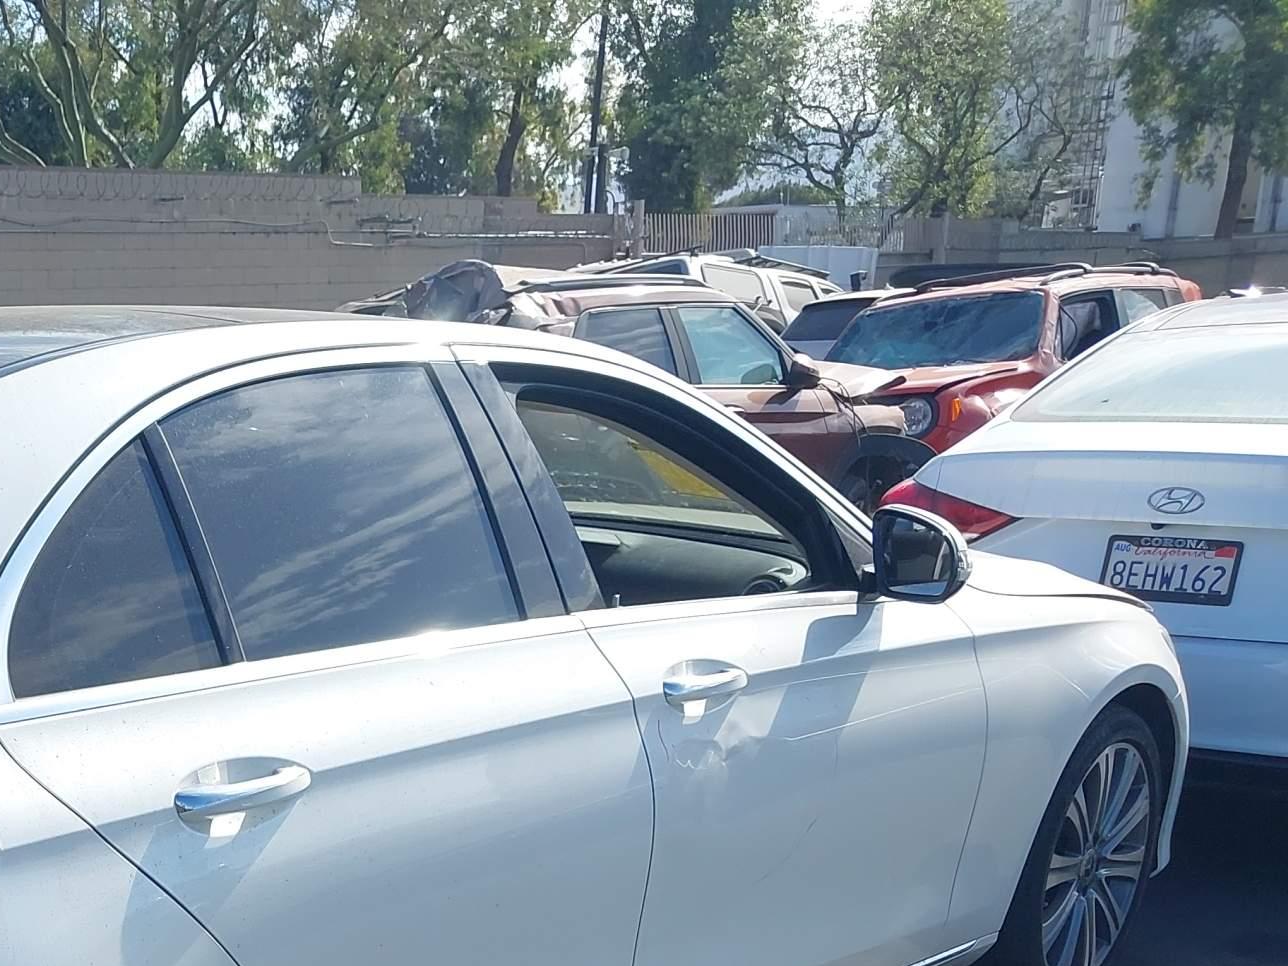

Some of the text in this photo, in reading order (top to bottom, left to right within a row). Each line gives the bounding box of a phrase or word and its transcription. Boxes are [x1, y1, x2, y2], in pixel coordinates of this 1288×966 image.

[1114, 543, 1131, 553] AUG
[1140, 537, 1209, 550] CORONA
[1110, 560, 1226, 595] 8EHW162
